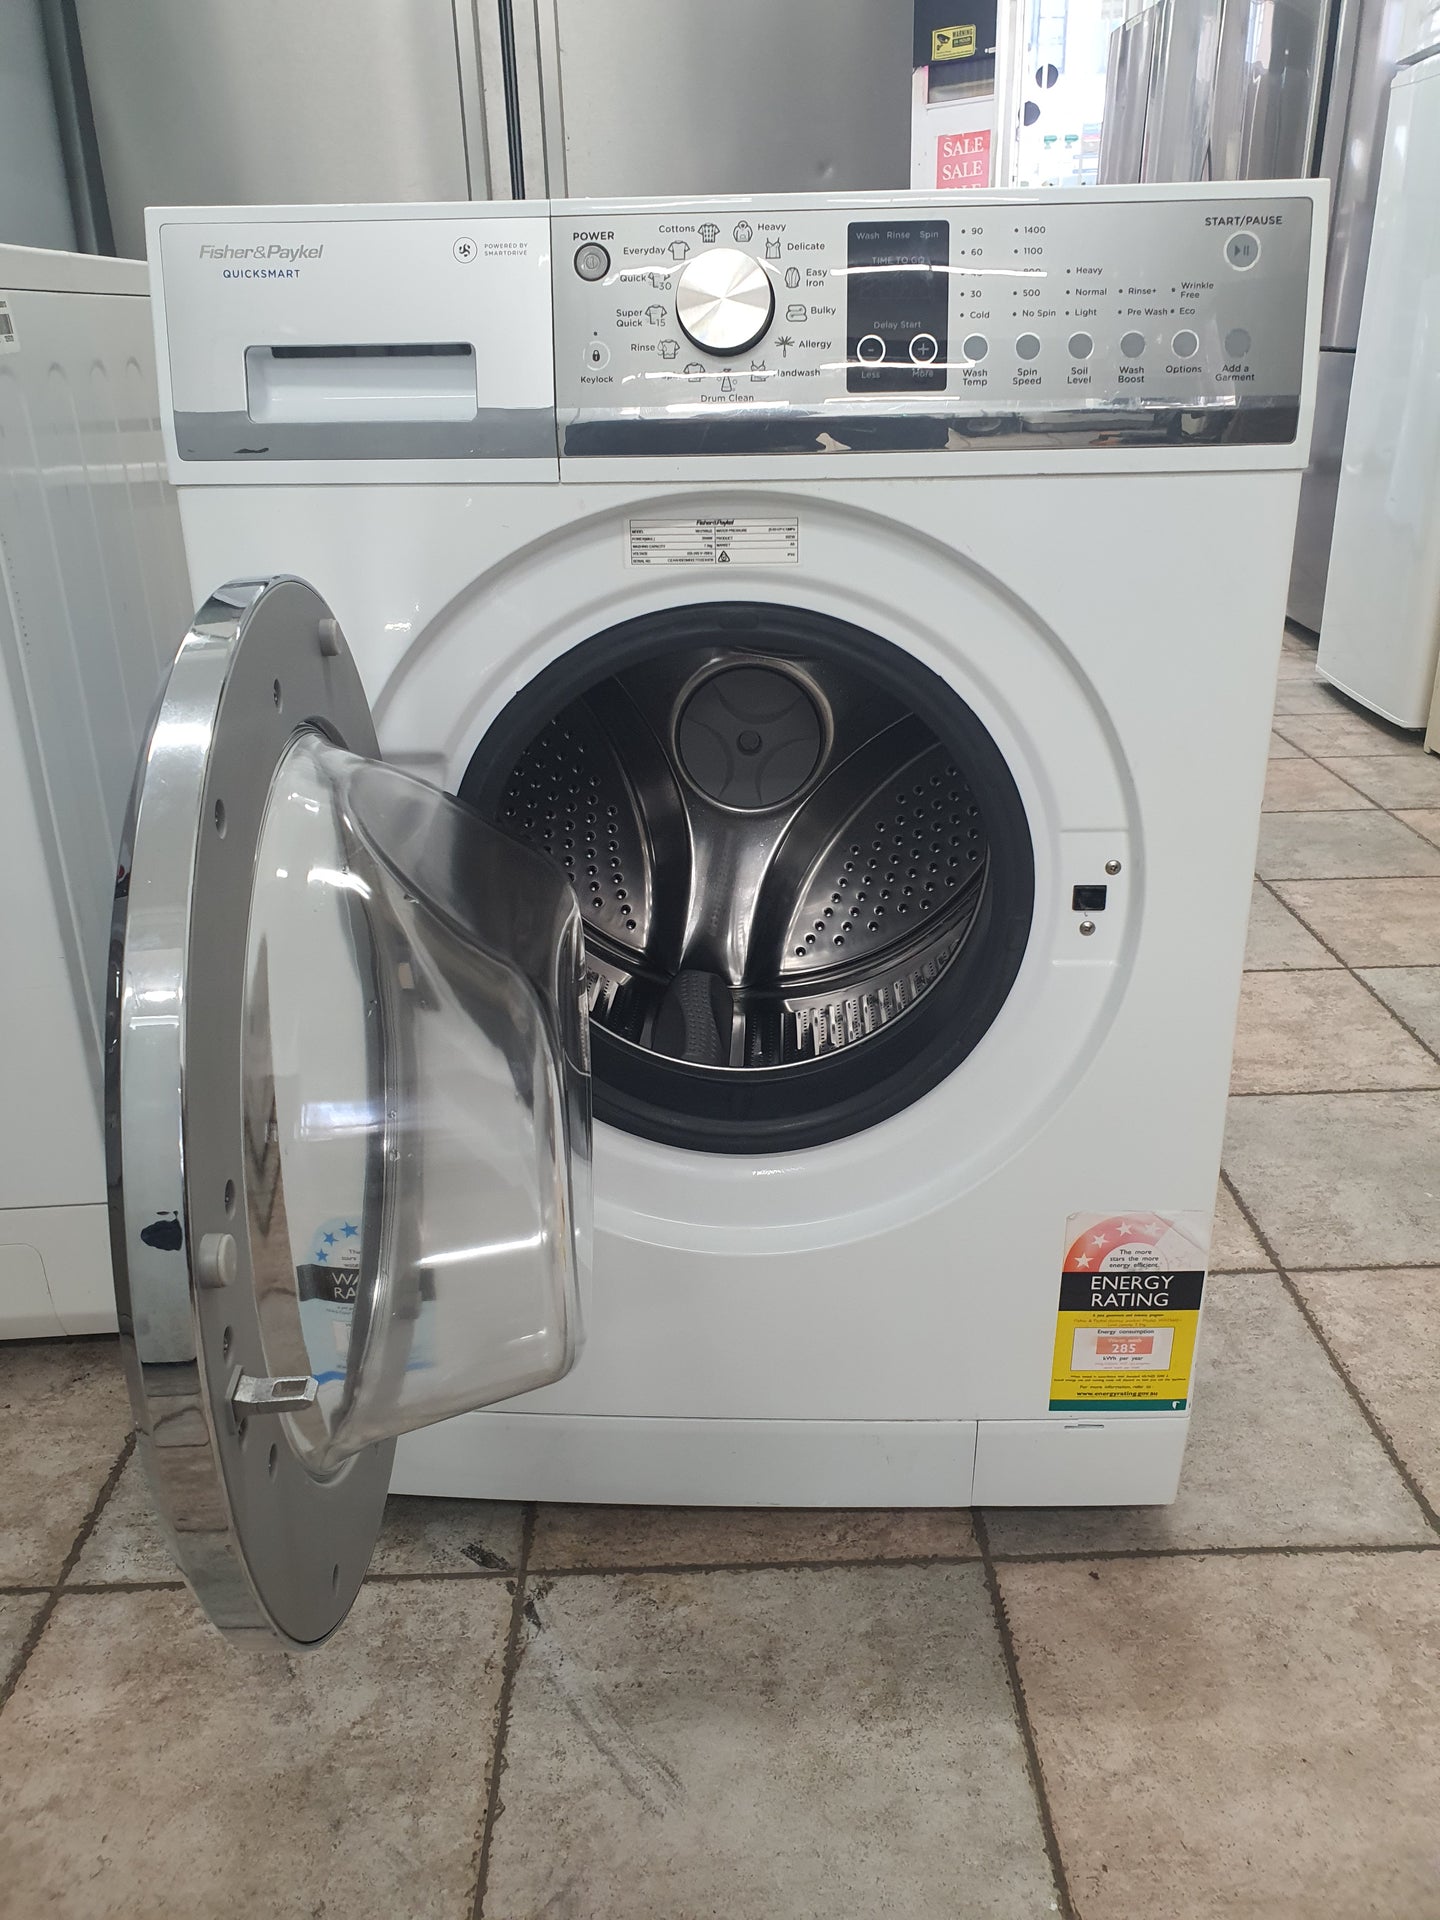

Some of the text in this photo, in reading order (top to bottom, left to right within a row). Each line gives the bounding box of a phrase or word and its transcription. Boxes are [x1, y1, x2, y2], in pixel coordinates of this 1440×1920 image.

[943, 137, 984, 157] SALE
[942, 161, 983, 180] SALE
[1205, 215, 1283, 227] START/PAUSE
[658, 224, 696, 233] Cottons
[757, 223, 787, 232] Heavy
[971, 227, 984, 235] 90
[1023, 226, 1046, 234] 1400
[572, 231, 615, 241] POWER
[855, 230, 939, 240] Wash Rinse Spin
[623, 246, 666, 256] Everyday
[787, 242, 825, 251] Delicate
[1023, 247, 1043, 255] 1100
[199, 243, 324, 263] Fisher&Paykel
[970, 248, 983, 256] 60
[223, 269, 300, 278] QUICKSMART
[805, 268, 828, 278] Easy
[1075, 266, 1103, 276] Heavy
[619, 274, 647, 282] Quick
[658, 282, 672, 291] 30
[805, 279, 825, 287] Iron
[1181, 281, 1214, 290] Wrinkle
[970, 290, 982, 298] 30
[1022, 289, 1041, 297] 500
[1075, 288, 1107, 296] Normal
[1128, 287, 1157, 295] Rinse+
[1180, 291, 1200, 299] Free
[616, 308, 643, 318] Super
[810, 306, 837, 315] Bulky
[969, 311, 990, 319] Cold
[1022, 308, 1057, 318] No Spin
[1074, 308, 1097, 318] Light
[1127, 308, 1168, 316] Pre Wash
[1179, 307, 1196, 315] Eco
[616, 319, 643, 328] Quick
[656, 319, 666, 327] 15
[873, 320, 922, 330] Delay Start
[630, 343, 656, 352] Rinse
[798, 340, 832, 349] Allergy
[1017, 367, 1038, 377] Spin
[1071, 366, 1089, 375] Soil
[1119, 366, 1145, 374] Wash
[1165, 364, 1202, 374] Options
[1221, 364, 1241, 372] Add
[861, 371, 881, 379] Less
[912, 369, 934, 378] More
[962, 369, 988, 377] Wash
[1214, 373, 1255, 382] Garment
[580, 375, 614, 384] Keylock
[962, 378, 988, 387] Temp
[1012, 376, 1042, 386] Speed
[1066, 376, 1092, 384] Level
[1117, 375, 1145, 383] Boost
[700, 393, 755, 402] Drum Clean
[1091, 1275, 1175, 1290] ENERGY
[1091, 1292, 1169, 1307] RATING
[1111, 1343, 1137, 1354] 285
